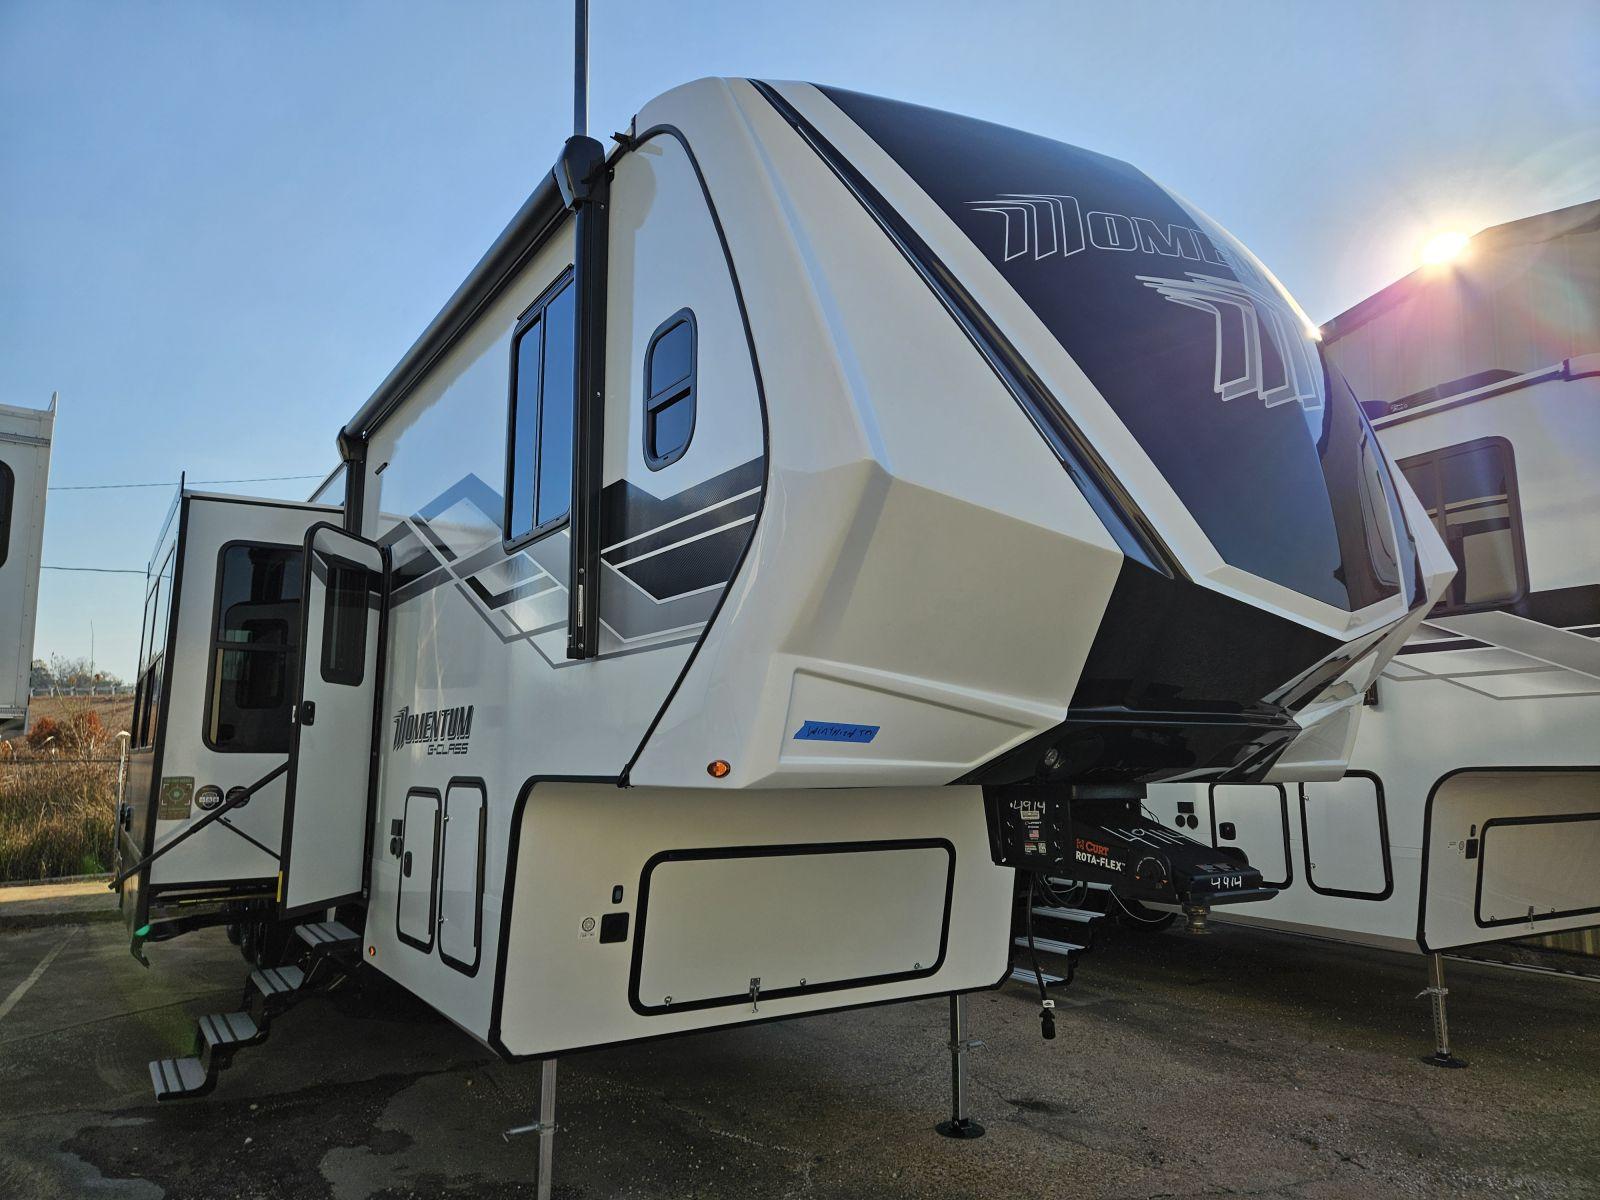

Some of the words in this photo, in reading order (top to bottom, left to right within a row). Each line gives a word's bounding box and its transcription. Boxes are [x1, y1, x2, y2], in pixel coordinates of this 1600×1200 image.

[393, 705, 475, 752] MOMENTUM
[427, 742, 469, 755] G-CLASS
[1085, 841, 1110, 856] CURT
[1210, 875, 1242, 890] 4914
